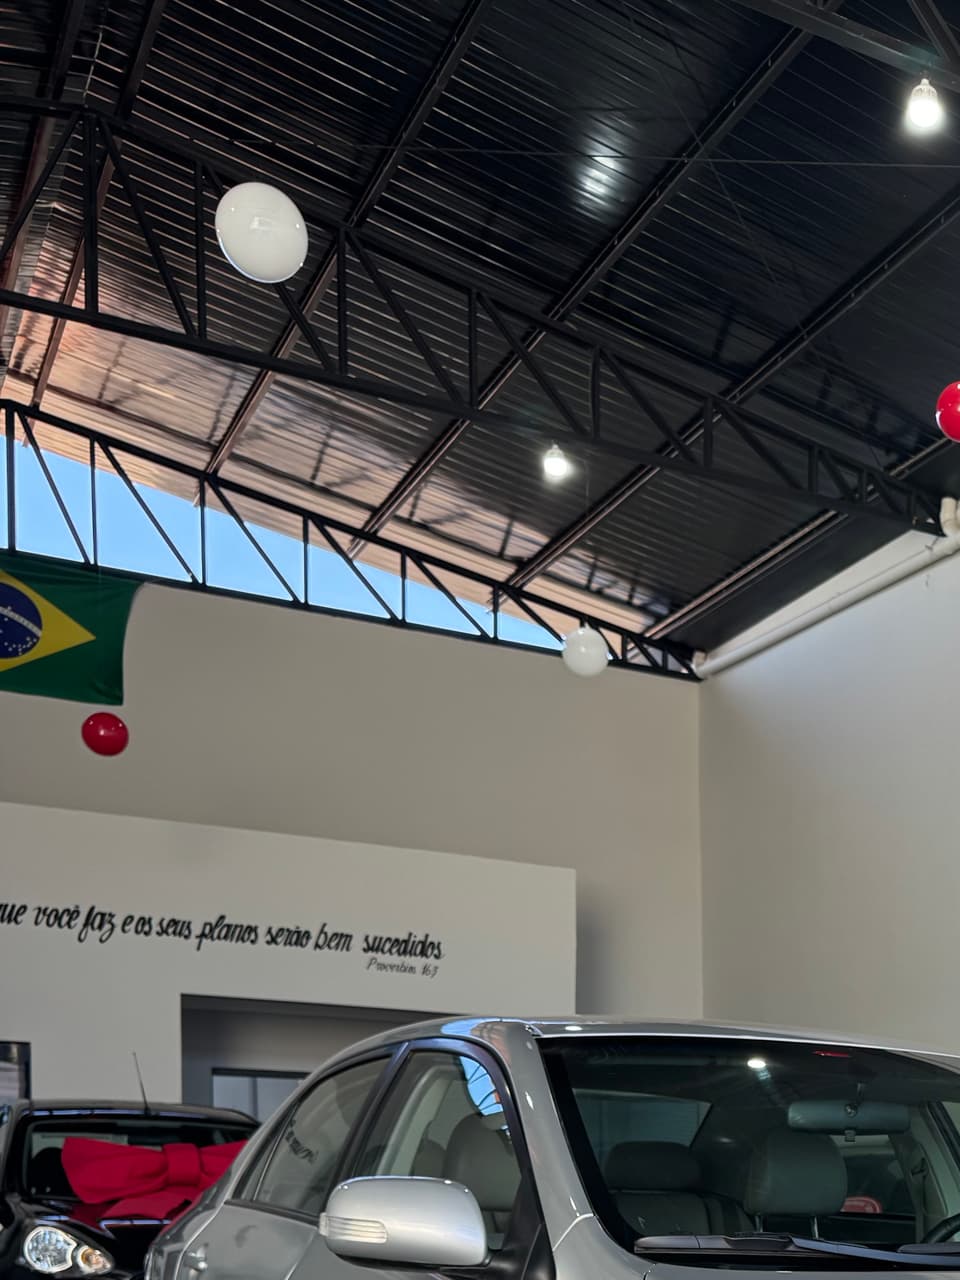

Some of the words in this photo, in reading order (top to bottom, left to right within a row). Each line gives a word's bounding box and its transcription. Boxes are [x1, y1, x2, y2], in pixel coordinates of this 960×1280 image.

[33, 904, 81, 929] você
[77, 905, 116, 944] faz
[156, 917, 192, 940] seus
[195, 914, 259, 950] planos
[313, 922, 353, 952] bem
[362, 932, 443, 960] sucedidos
